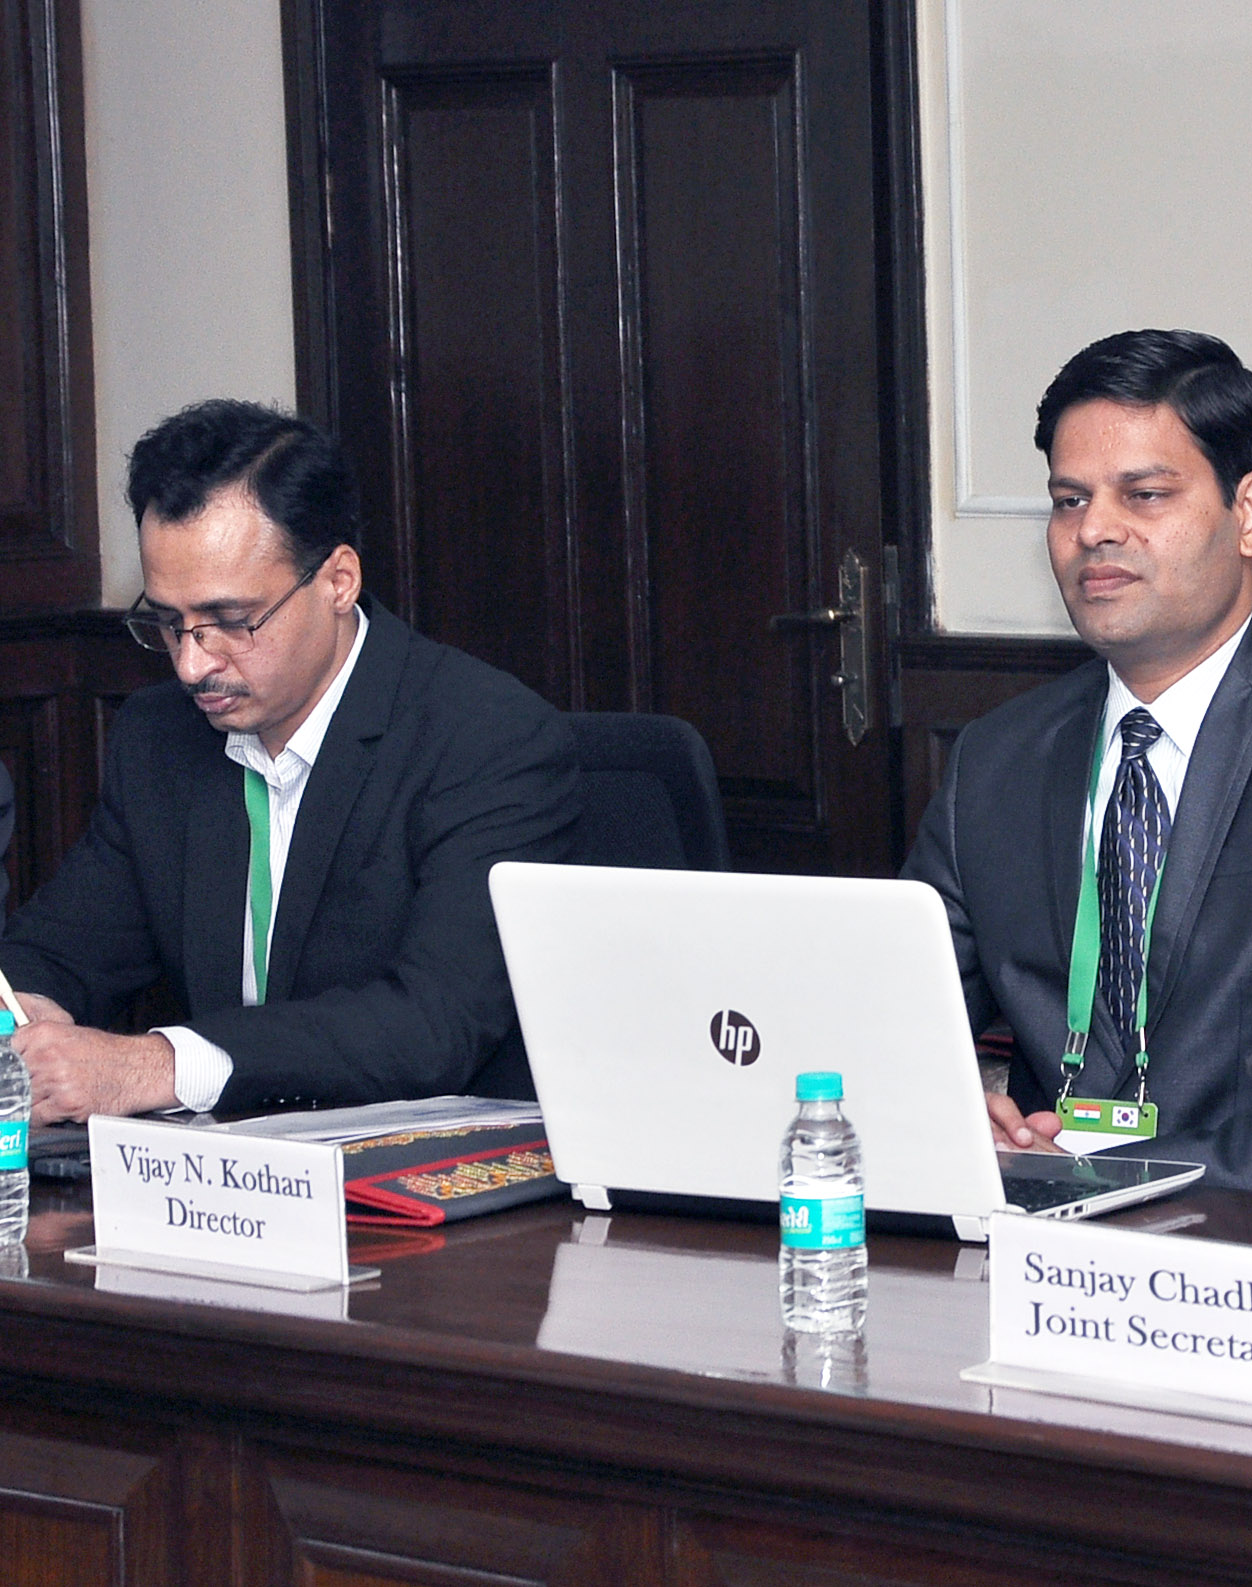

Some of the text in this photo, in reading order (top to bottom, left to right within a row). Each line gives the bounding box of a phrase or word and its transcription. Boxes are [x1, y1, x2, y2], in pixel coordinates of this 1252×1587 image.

[718, 1008, 754, 1067] hp
[117, 1144, 313, 1199] Vijay N. Kothari
[165, 1197, 266, 1239] Director
[1024, 1252, 1135, 1301] Sanjay
[1025, 1301, 1116, 1342] Joint
